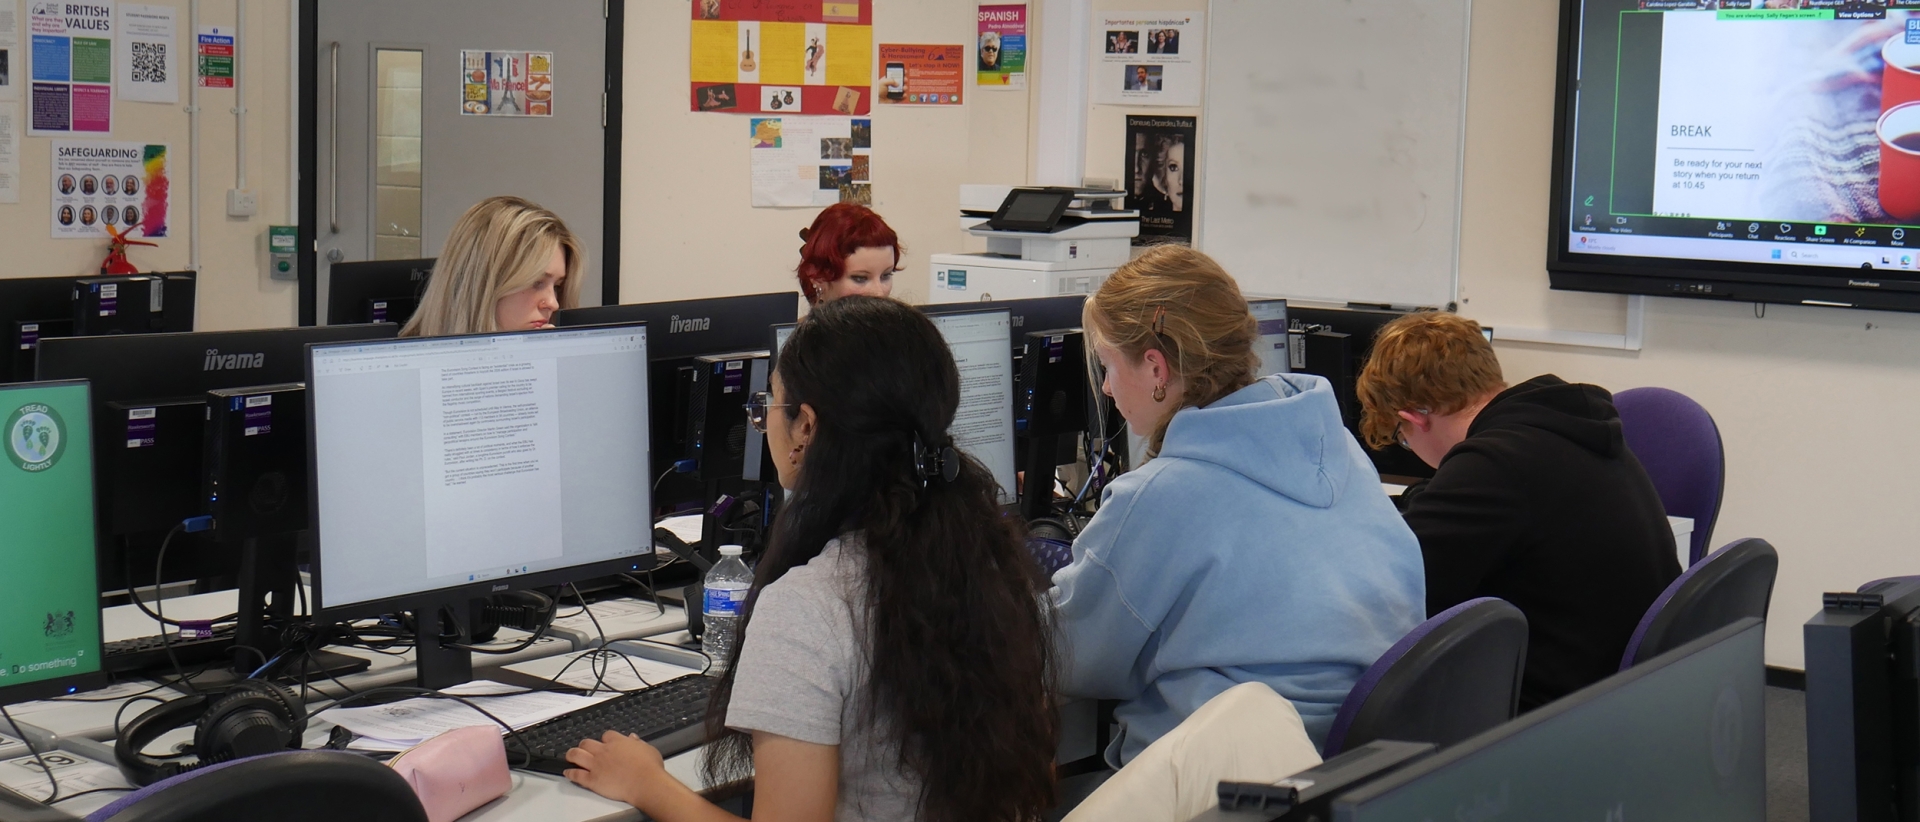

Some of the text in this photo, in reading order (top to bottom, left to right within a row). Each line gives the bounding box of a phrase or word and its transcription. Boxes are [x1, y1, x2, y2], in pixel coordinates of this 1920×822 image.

[66, 4, 109, 17] BRITISH
[978, 11, 1019, 22] SPANISH
[65, 18, 110, 31] VALUES
[490, 78, 499, 90] Ma
[1671, 125, 1712, 137] BREAK
[58, 147, 138, 158] SAFEGUARDING
[1674, 159, 1685, 167] Be
[1687, 160, 1709, 169] ready
[1673, 171, 1693, 179] story
[1683, 181, 1705, 189] 10.45
[670, 315, 710, 333] iiyama
[203, 349, 264, 371] iiyama
[19, 404, 48, 415] TREAD
[22, 459, 52, 471] LIGHTLY
[12, 664, 26, 674] Do
[28, 657, 76, 672] something
